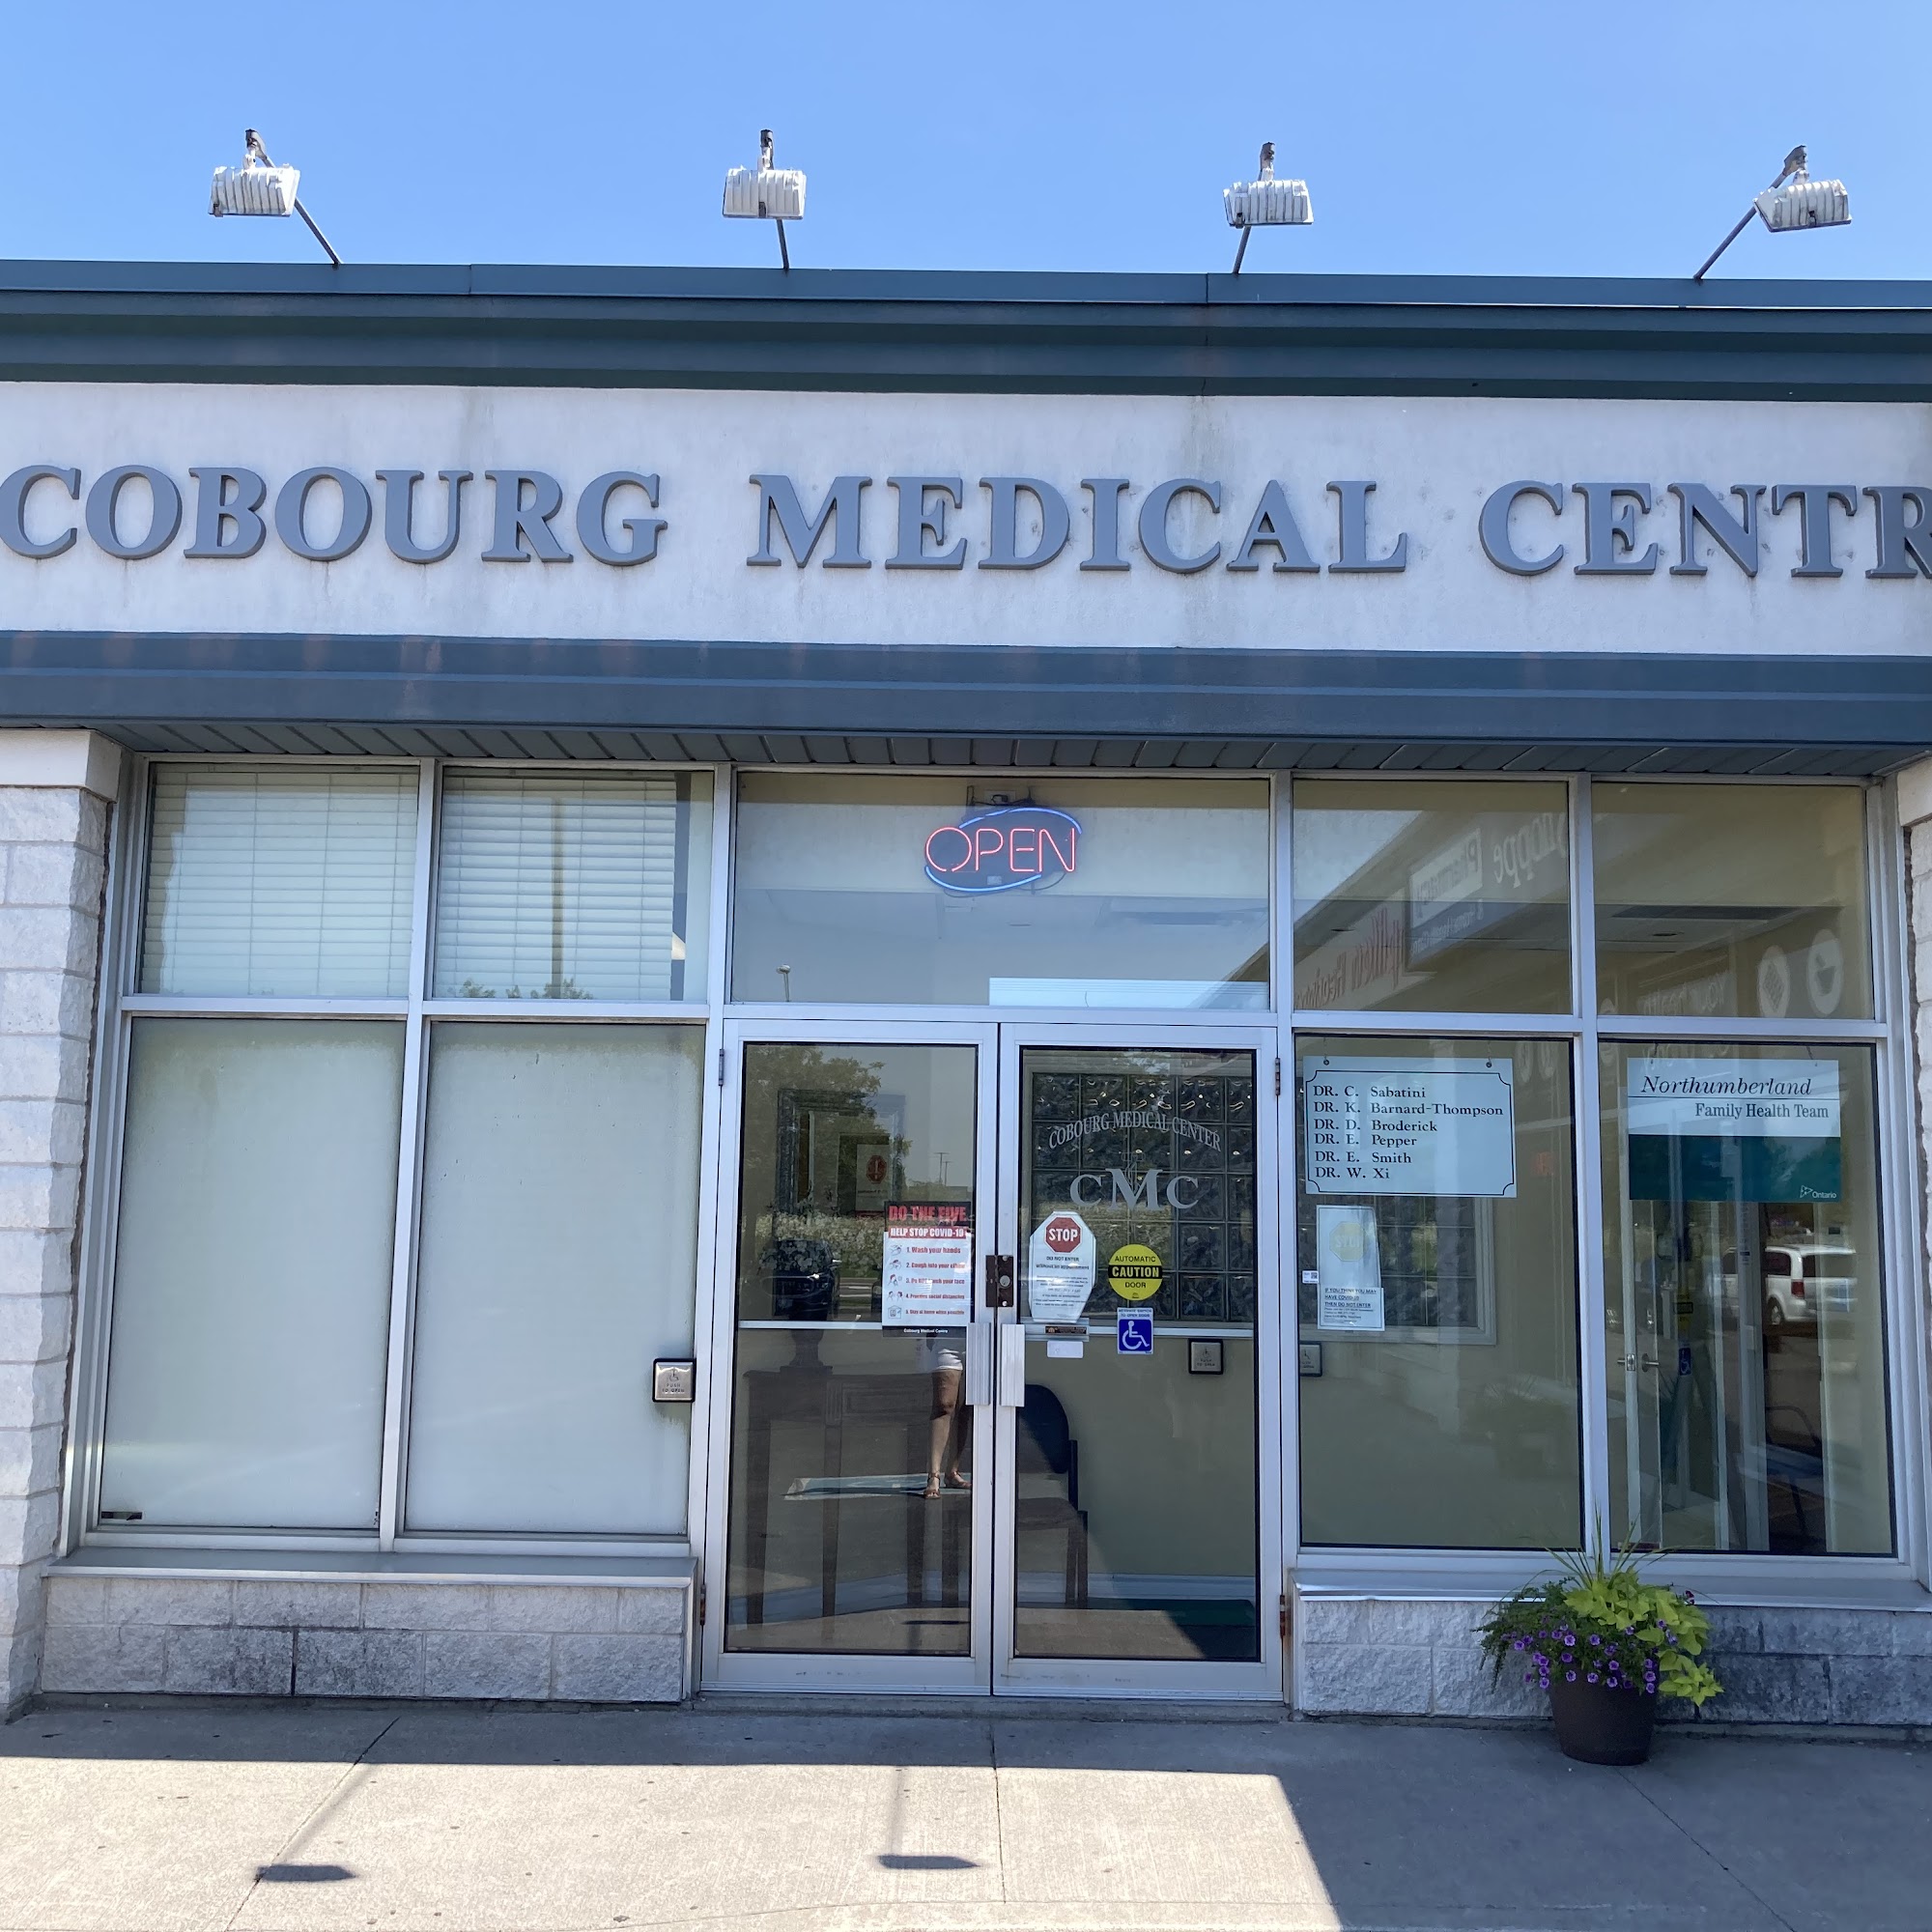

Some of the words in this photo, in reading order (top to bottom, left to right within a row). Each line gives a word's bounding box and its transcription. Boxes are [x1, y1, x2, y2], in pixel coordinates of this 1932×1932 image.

[0, 465, 668, 567] COBOURG
[747, 474, 1407, 574] MEDICAL
[1478, 479, 1932, 580] CENTR
[924, 826, 1076, 873] OPEN
[1313, 1085, 1339, 1097] DR.
[1344, 1085, 1359, 1097] C.
[1370, 1086, 1427, 1098] Sabatini
[1640, 1075, 1812, 1095] Northumberland
[1314, 1101, 1339, 1113] DR.
[1346, 1101, 1361, 1113] K.
[1371, 1102, 1504, 1118] Barnard-Thompson
[1695, 1102, 1743, 1120] Family
[1746, 1103, 1790, 1118] Health
[1794, 1103, 1829, 1118] Team
[1048, 1112, 1110, 1150] COBOURG
[1112, 1110, 1171, 1131] MEDICAL
[1171, 1116, 1222, 1152] CENTER
[1314, 1119, 1339, 1130] DR.
[1346, 1119, 1361, 1130] D.
[1372, 1119, 1437, 1132] Broderick
[1314, 1133, 1340, 1145] DR.
[1346, 1133, 1359, 1146] E.
[1372, 1134, 1417, 1148] Pepper
[1315, 1151, 1340, 1162] DR.
[1347, 1151, 1360, 1163] E.
[1372, 1151, 1412, 1164] Smith
[1315, 1167, 1341, 1179] DR.
[1347, 1167, 1366, 1179] W.
[1373, 1168, 1390, 1179] Xi
[1069, 1168, 1199, 1211] CMC
[1812, 1190, 1836, 1199] Ontario
[889, 1206, 907, 1221] DO
[911, 1206, 934, 1221] THE
[937, 1206, 966, 1222] FIVE
[890, 1228, 908, 1236] HELP
[909, 1228, 927, 1236] STOP
[929, 1228, 964, 1237] COVID-19
[1048, 1228, 1079, 1242] STOP
[1112, 1265, 1159, 1278] CAUTION
